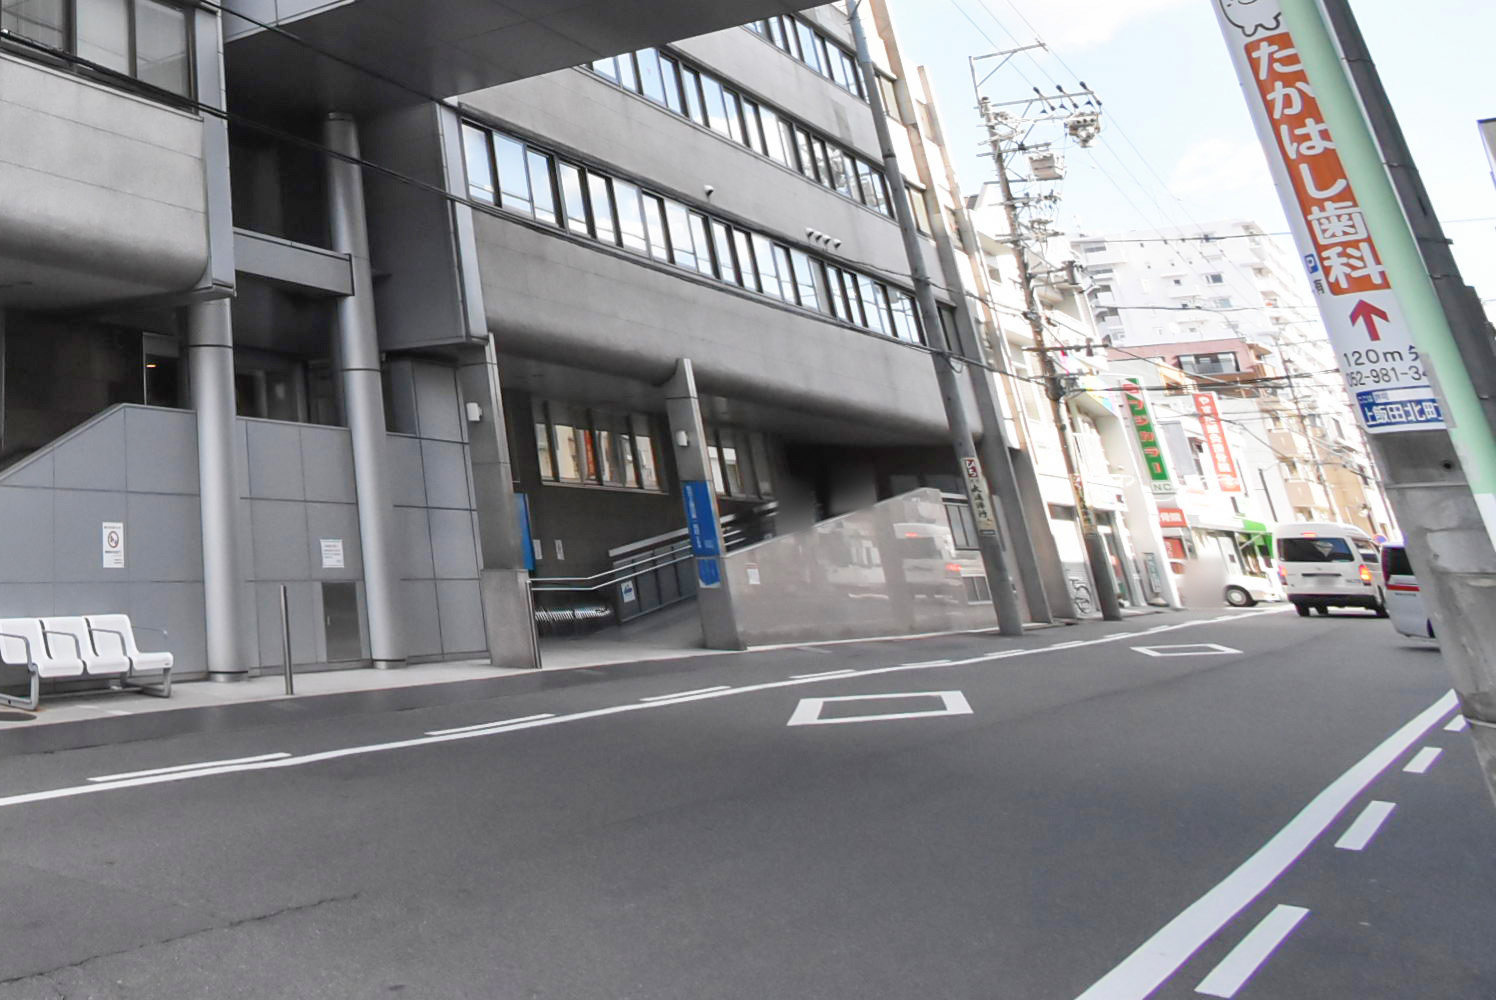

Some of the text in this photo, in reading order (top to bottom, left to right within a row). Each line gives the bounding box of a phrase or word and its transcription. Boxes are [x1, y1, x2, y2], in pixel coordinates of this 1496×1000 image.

[1251, 38, 1388, 291] たかはし歯科
